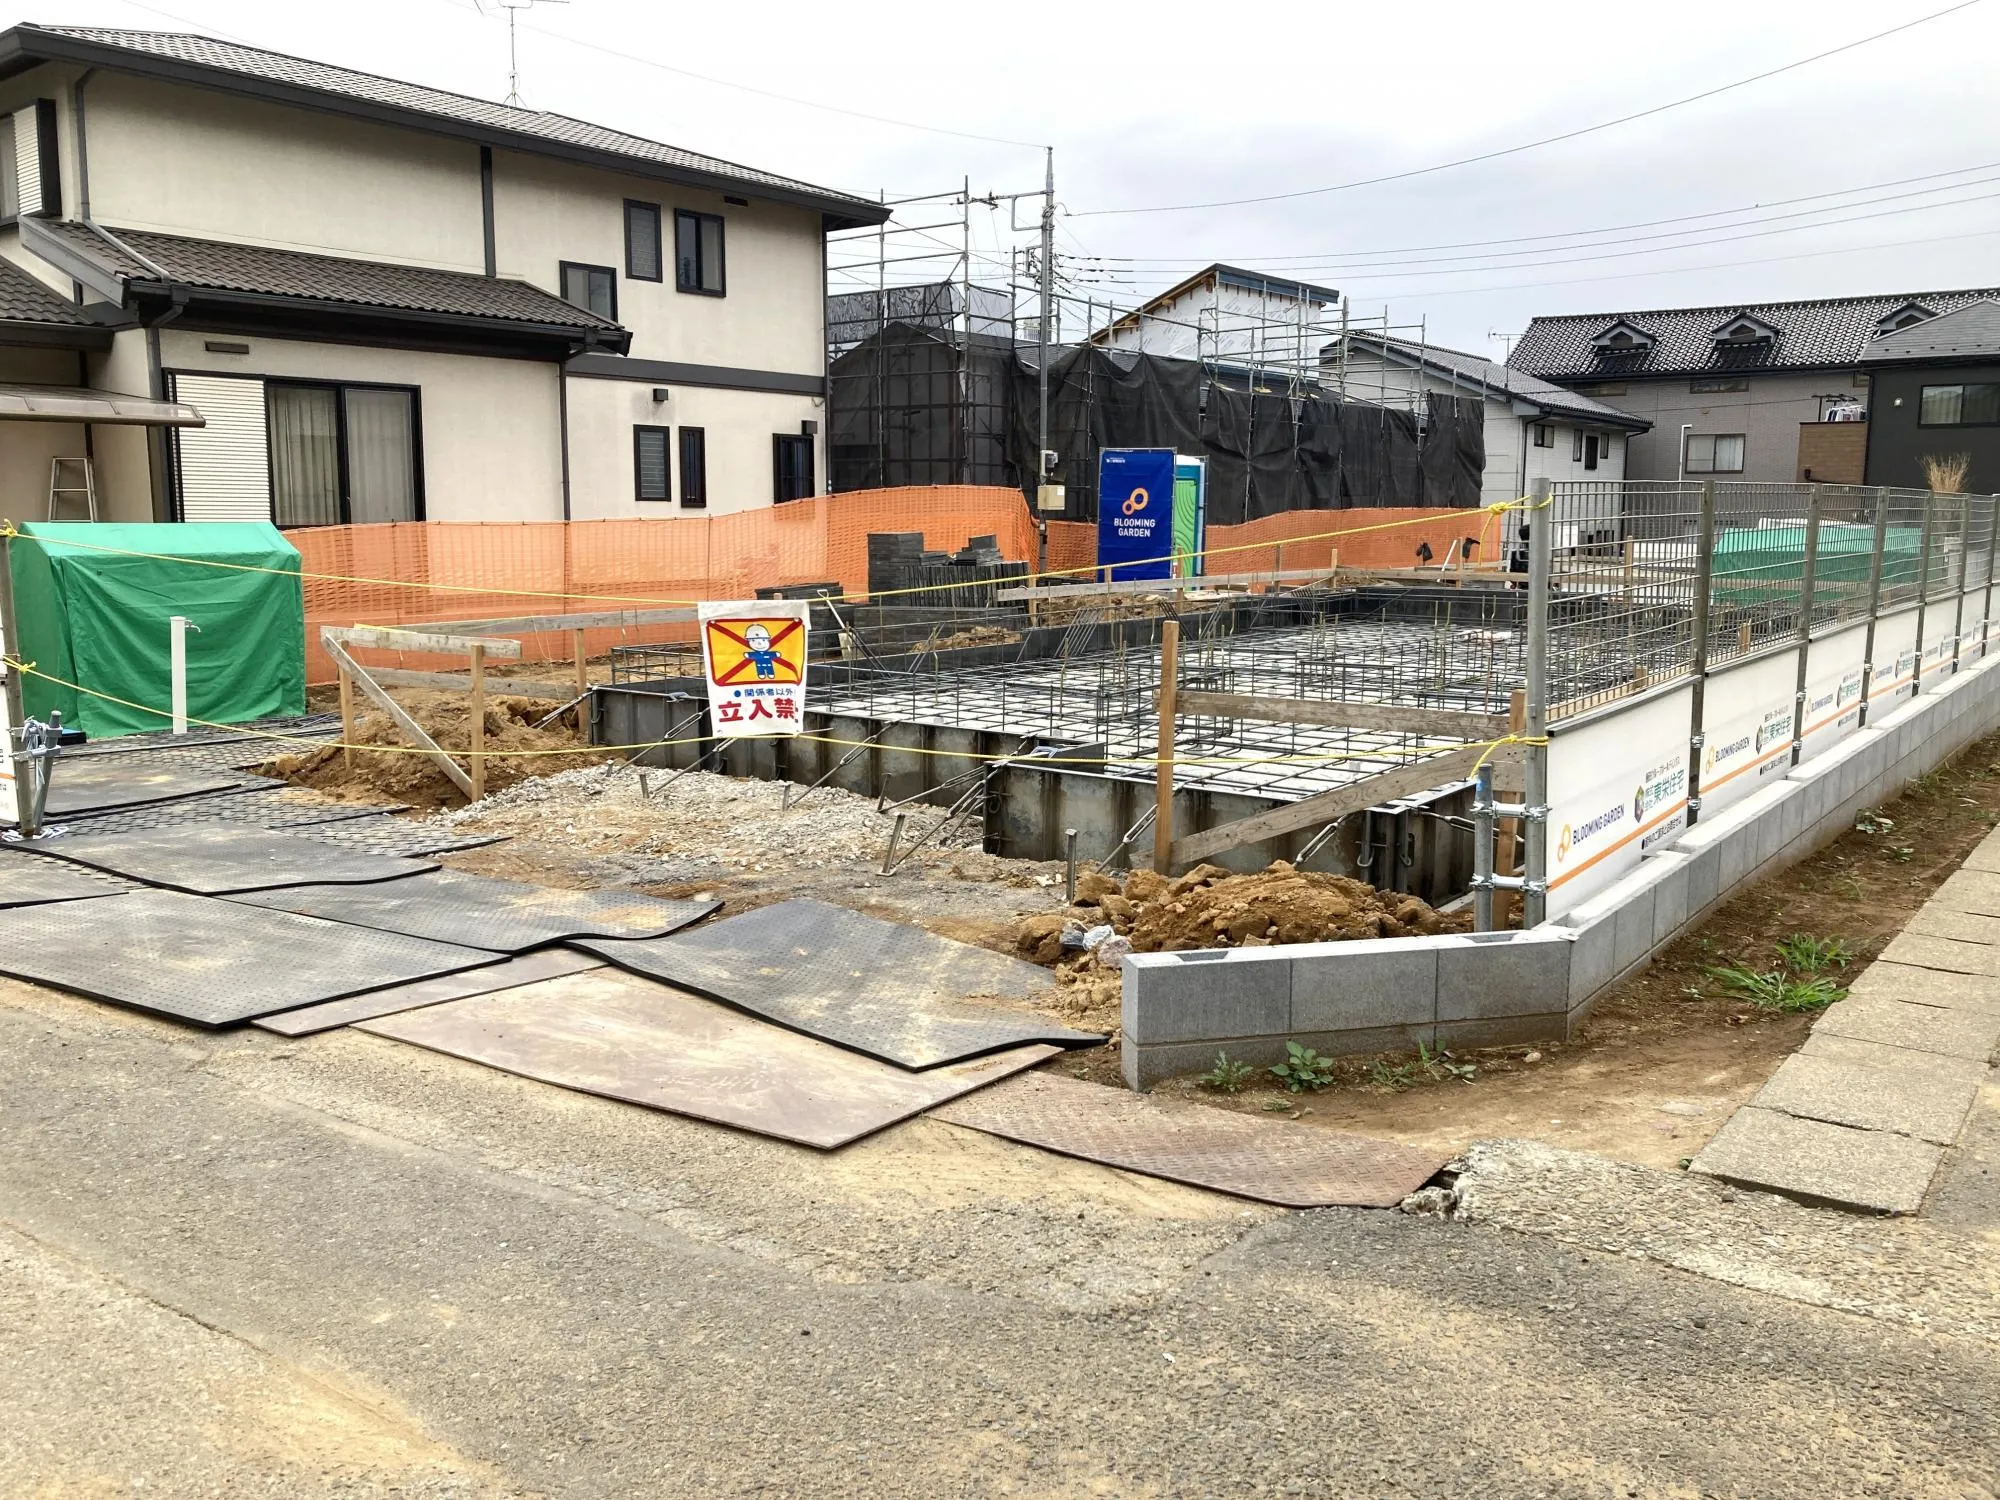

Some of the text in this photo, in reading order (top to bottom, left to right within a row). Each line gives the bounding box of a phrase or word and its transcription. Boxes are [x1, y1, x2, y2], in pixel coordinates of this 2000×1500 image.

[1113, 517, 1156, 528] BLOOMING
[1118, 527, 1151, 537] GARDEN
[744, 687, 794, 697] 関係者以外
[718, 697, 798, 723] 立入禁
[1573, 803, 1625, 845] BLOOMING GARDEN
